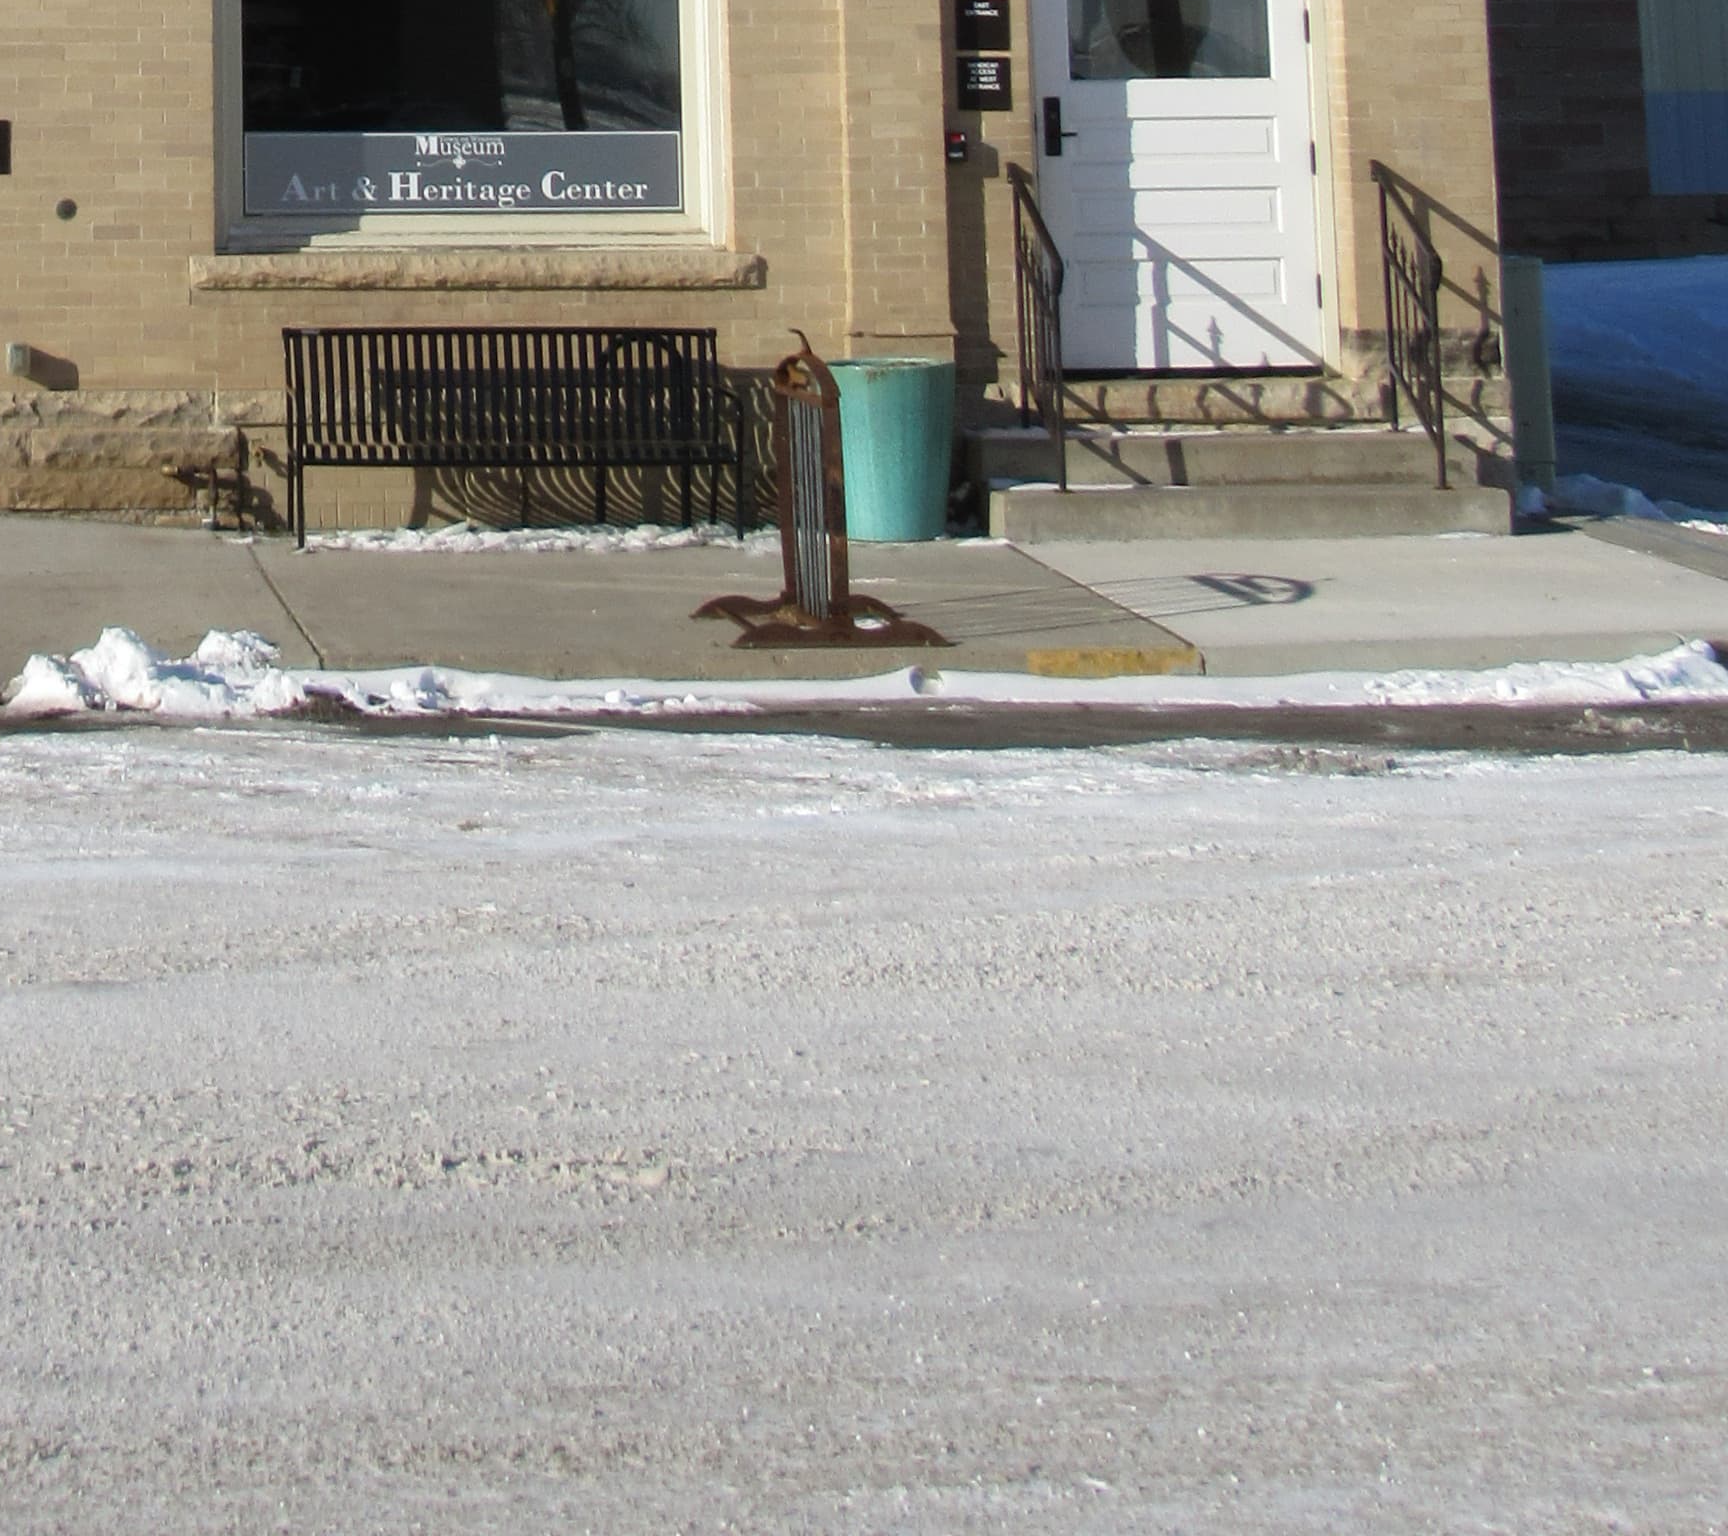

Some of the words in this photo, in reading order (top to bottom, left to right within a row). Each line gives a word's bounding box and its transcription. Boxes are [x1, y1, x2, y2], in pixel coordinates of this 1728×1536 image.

[415, 135, 505, 156] Museum
[280, 172, 338, 201] Art
[351, 176, 377, 201] &
[387, 171, 532, 209] Heritage
[541, 170, 648, 200] Center
